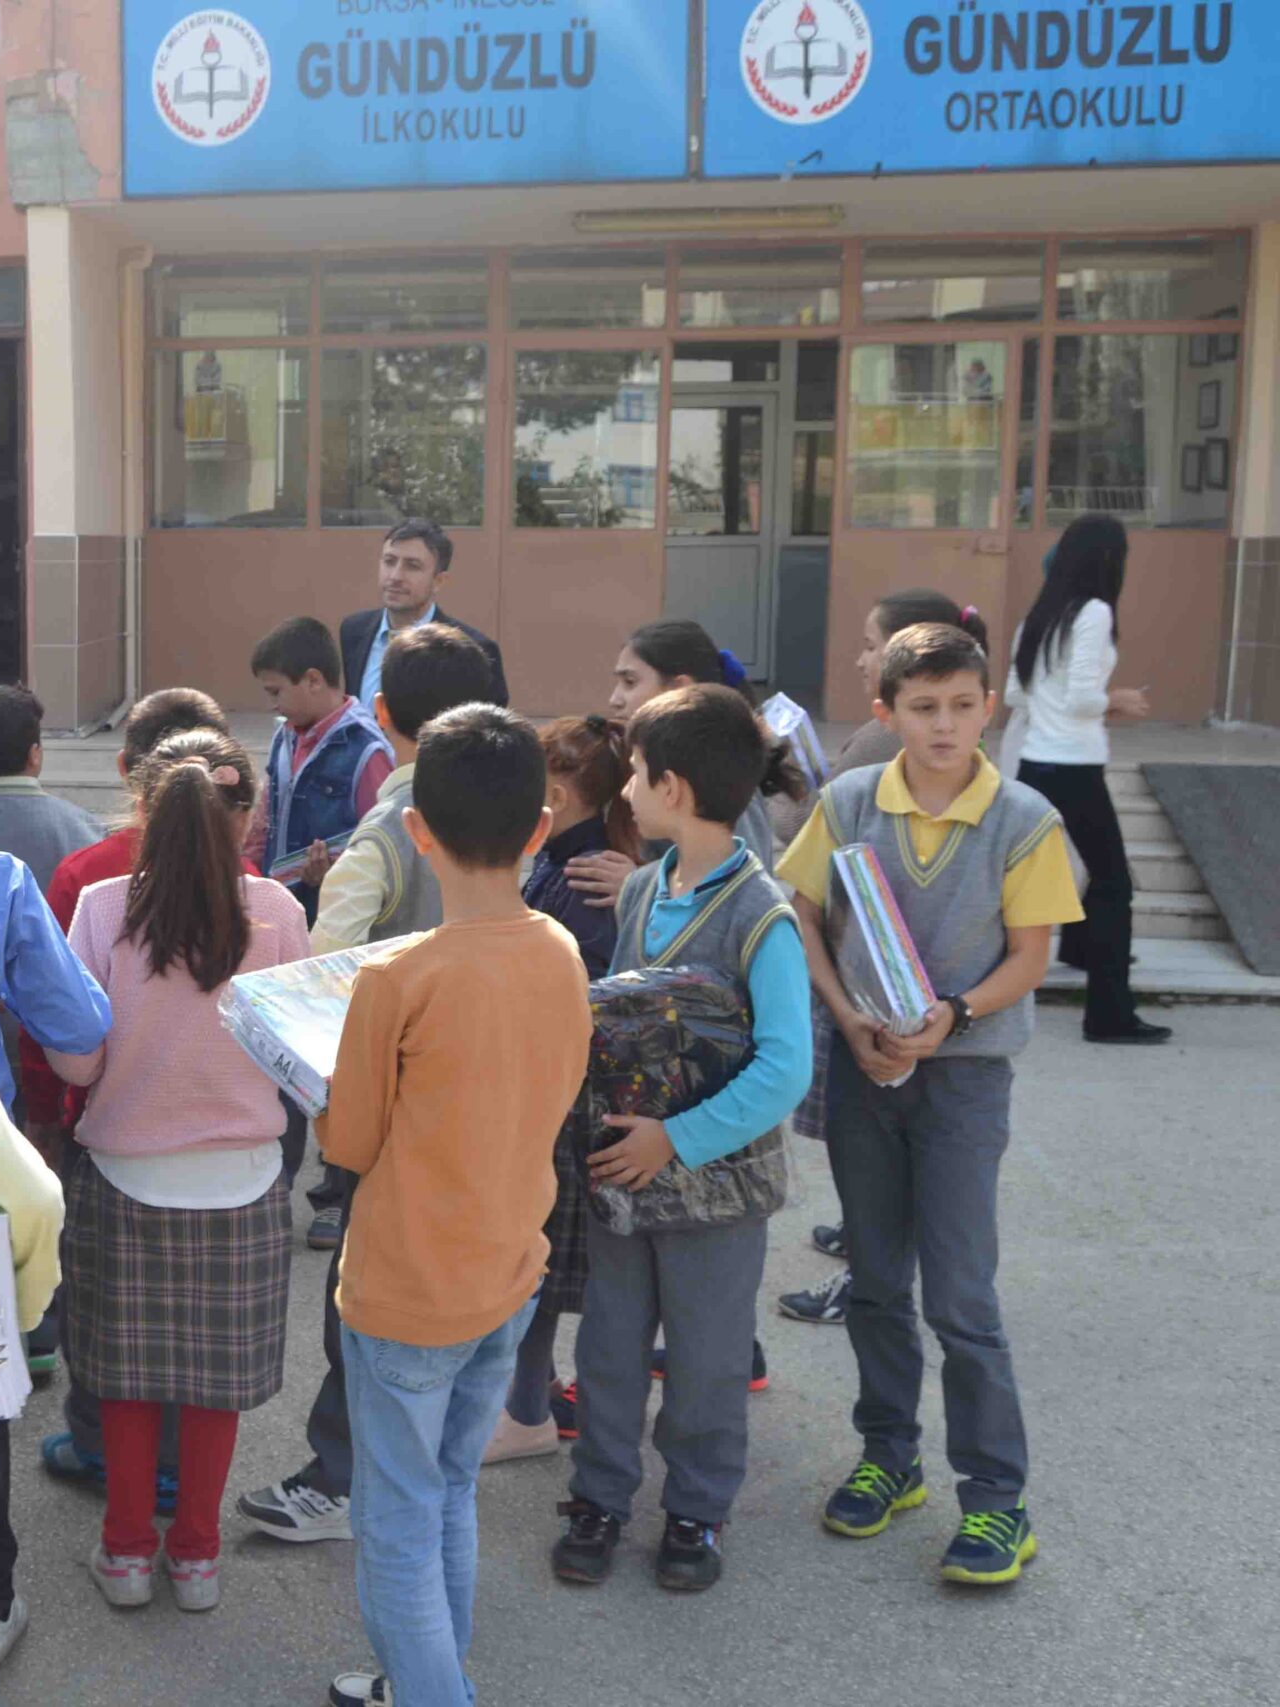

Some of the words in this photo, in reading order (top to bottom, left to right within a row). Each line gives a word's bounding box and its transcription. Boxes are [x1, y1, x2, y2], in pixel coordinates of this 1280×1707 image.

[297, 18, 597, 99] GÜNDÜZLÜ
[362, 106, 527, 144] İLKOKULU
[945, 84, 1184, 132] ORTAOKULU
[273, 1052, 293, 1077] A4
